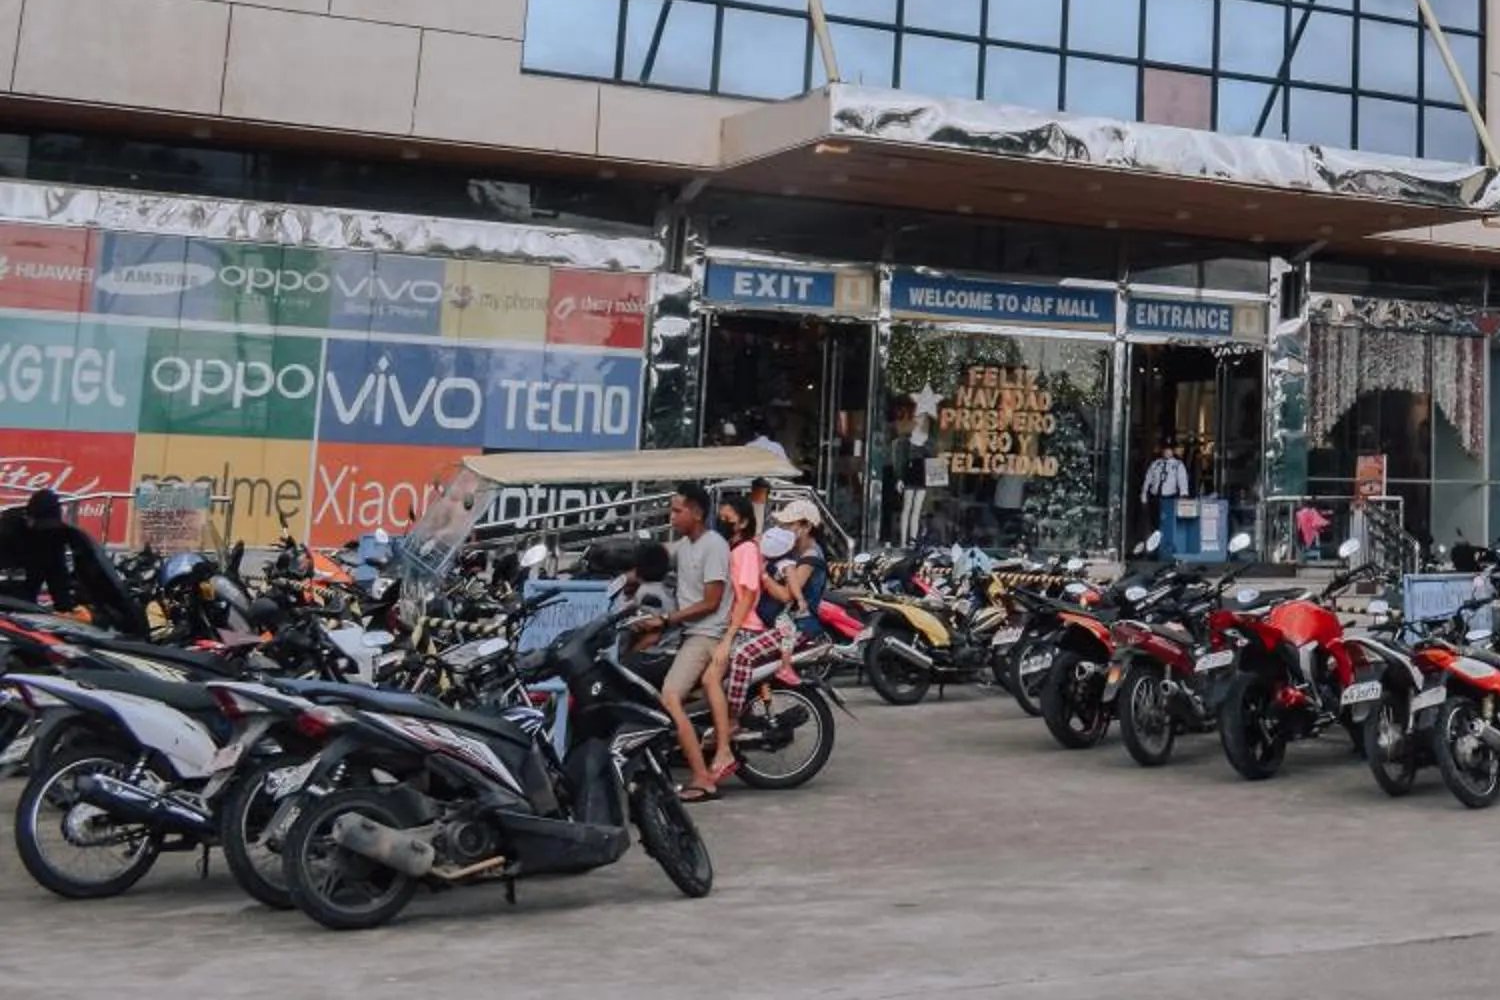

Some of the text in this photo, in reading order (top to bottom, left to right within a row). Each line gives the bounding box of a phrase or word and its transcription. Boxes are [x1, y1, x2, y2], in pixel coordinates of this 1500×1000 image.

[15, 263, 95, 283] HUAWEI
[733, 271, 814, 299] EXIT
[908, 287, 1099, 319] WELCOME TO J&F MALL
[1135, 303, 1229, 332] ENTRANCE
[151, 357, 315, 408] oppo
[326, 356, 482, 429] vivo
[967, 366, 1038, 390] FELIZ
